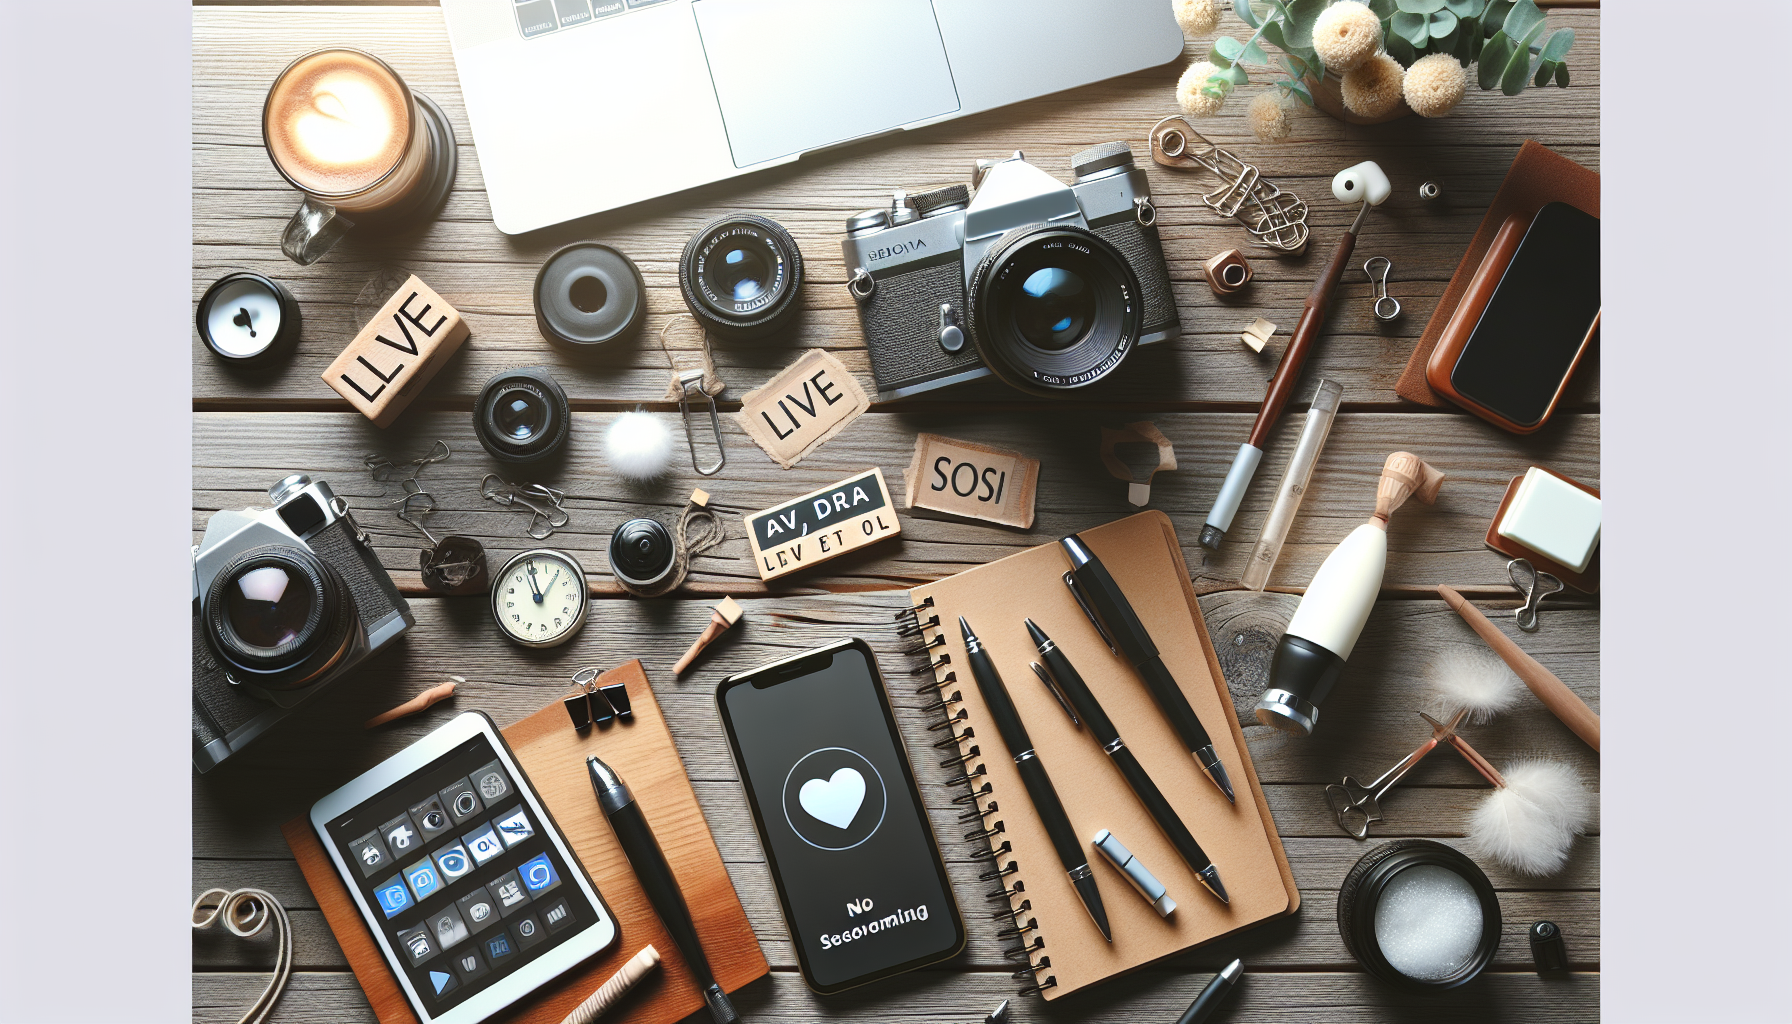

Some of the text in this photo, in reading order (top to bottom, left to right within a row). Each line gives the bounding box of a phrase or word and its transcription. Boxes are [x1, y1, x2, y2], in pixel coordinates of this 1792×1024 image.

[340, 291, 448, 403] LLVE
[761, 369, 844, 440] LIVE
[931, 456, 1006, 505] SOSI
[813, 486, 870, 520] DRA
[861, 515, 890, 536] OL
[846, 898, 874, 918] No
